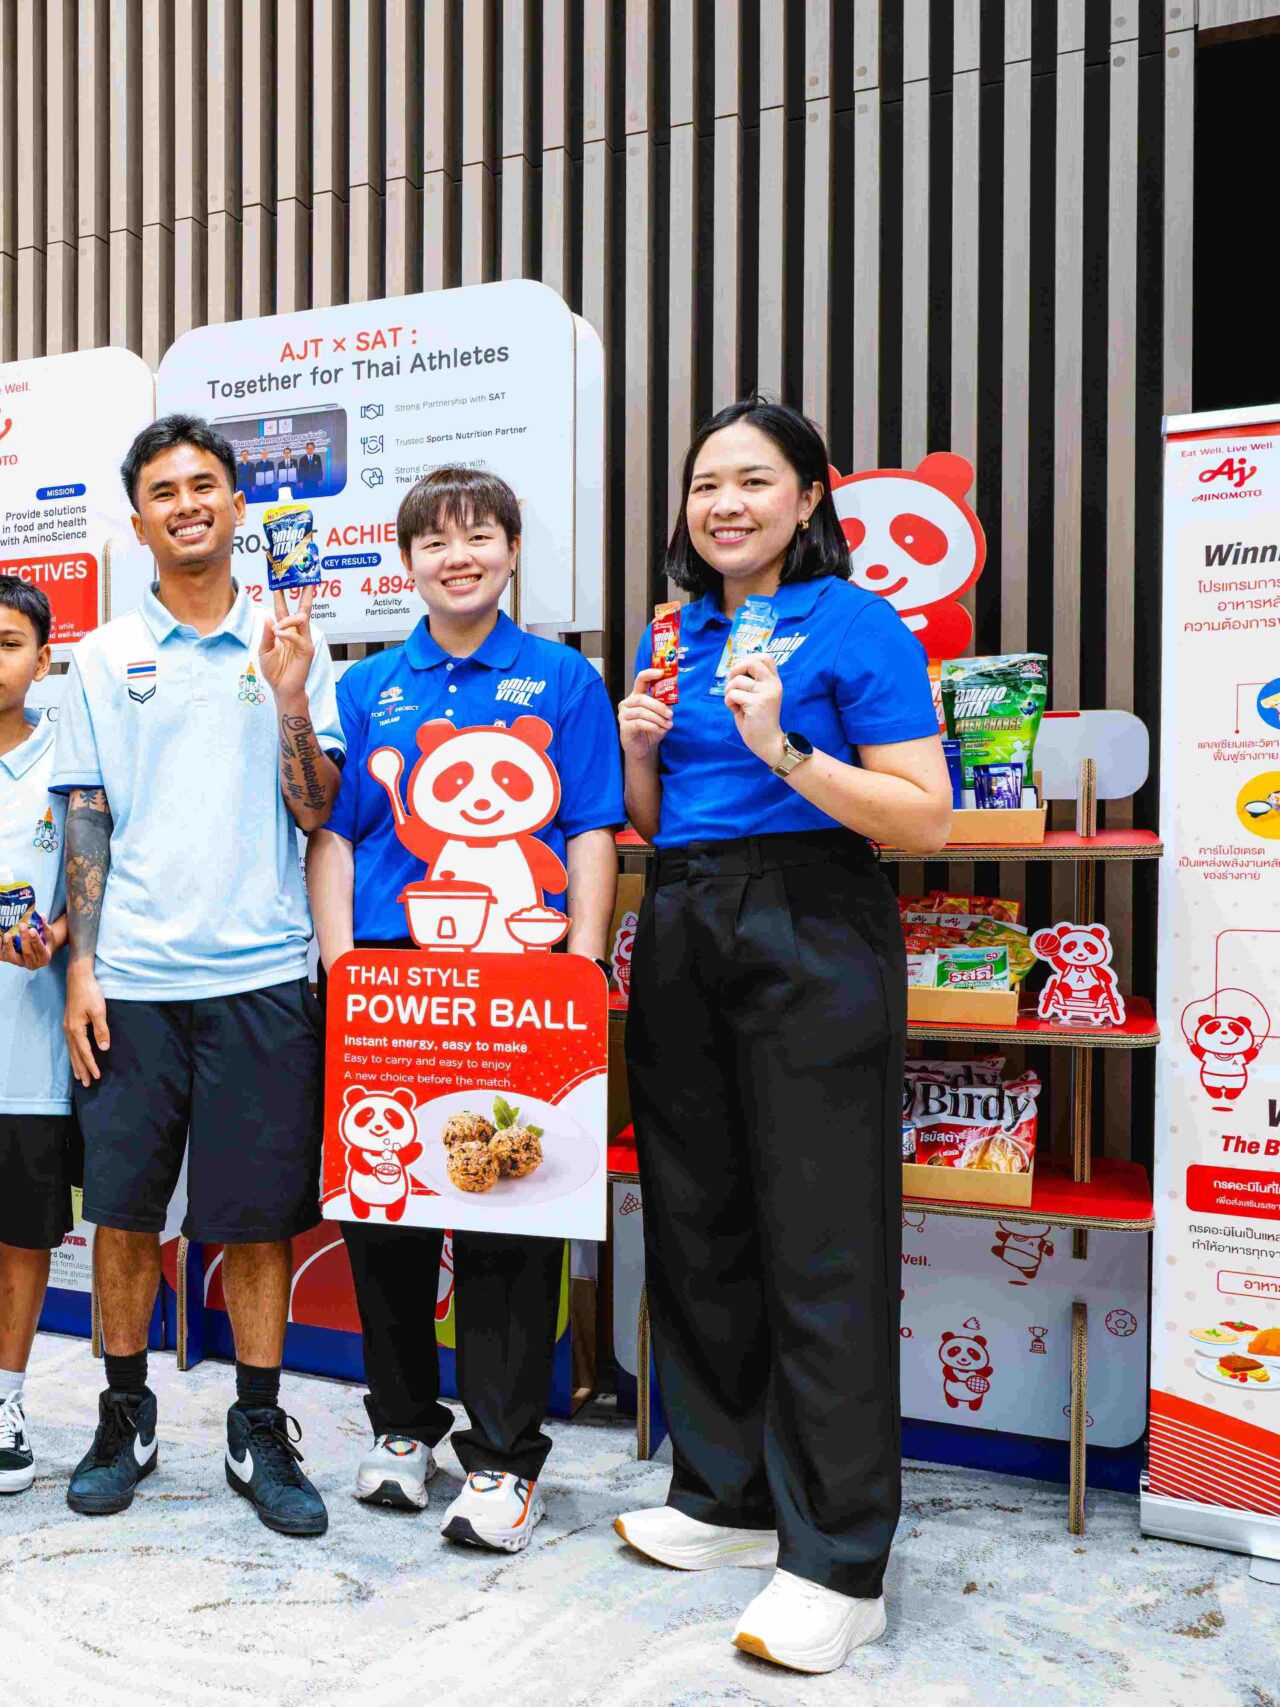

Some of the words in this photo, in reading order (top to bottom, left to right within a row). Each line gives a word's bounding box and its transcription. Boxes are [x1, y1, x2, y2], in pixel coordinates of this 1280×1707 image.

[280, 338, 324, 363] AJT
[356, 327, 403, 352] SAT
[207, 372, 303, 400] Together
[310, 365, 344, 386] for
[352, 355, 402, 380] Thai
[410, 345, 510, 374] Athletes
[5, 381, 32, 394] Well.
[395, 402, 421, 414] Strong
[423, 397, 468, 410] Partnership
[470, 393, 487, 404] with
[488, 391, 506, 402] SAT
[395, 435, 424, 447] Trusted
[426, 432, 453, 445] Sports
[456, 428, 494, 441] Nutrition
[495, 424, 527, 436] Partner
[1181, 449, 1197, 457] Eat
[1227, 444, 1248, 453] Live
[395, 465, 420, 475] Strong
[469, 458, 486, 468] with
[1198, 457, 1257, 488] Aj
[395, 475, 412, 484] Thai
[46, 487, 75, 497] MISSION
[1191, 489, 1262, 503] AJINOMOTO
[6, 510, 41, 521] Provide
[43, 504, 87, 517] solutions
[2, 525, 11, 534] in
[14, 523, 34, 533] food
[37, 520, 55, 531] and
[57, 516, 87, 528] health
[0, 536, 20, 547] with
[23, 530, 87, 545] AminoScience
[324, 559, 339, 568] KEY
[341, 555, 378, 566] RESULTS
[1204, 541, 1280, 567] Winn
[361, 575, 415, 596] 4,894
[365, 606, 411, 617] Participants
[373, 598, 403, 608] Activity
[1184, 616, 1280, 632] ความต้องการ
[498, 676, 546, 695] amino
[955, 685, 1008, 704] amino
[953, 700, 993, 719] VITAL
[983, 716, 1024, 731] CHARGE
[346, 966, 398, 986] THAI
[407, 967, 481, 988] STYLE
[346, 994, 477, 1027] POWER
[490, 998, 588, 1030] BALL
[344, 1034, 388, 1047] Instant
[391, 1038, 438, 1050] energy,
[442, 1041, 471, 1053] easy
[476, 1041, 489, 1051] to
[493, 1041, 528, 1053] make
[344, 1053, 368, 1064] Easy
[371, 1055, 382, 1063] to
[385, 1057, 412, 1067] carry
[415, 1056, 435, 1067] and
[439, 1060, 463, 1069] easy
[467, 1059, 478, 1068] to
[481, 1061, 511, 1071] enjoy
[344, 1071, 352, 1079] A
[355, 1073, 376, 1081] new
[380, 1072, 414, 1083] choice
[417, 1073, 452, 1084] before
[456, 1075, 473, 1085] the
[477, 1077, 511, 1087] match
[919, 1083, 1031, 1133] Birdy
[1221, 1135, 1260, 1155] The
[59, 1252, 75, 1261] Day)
